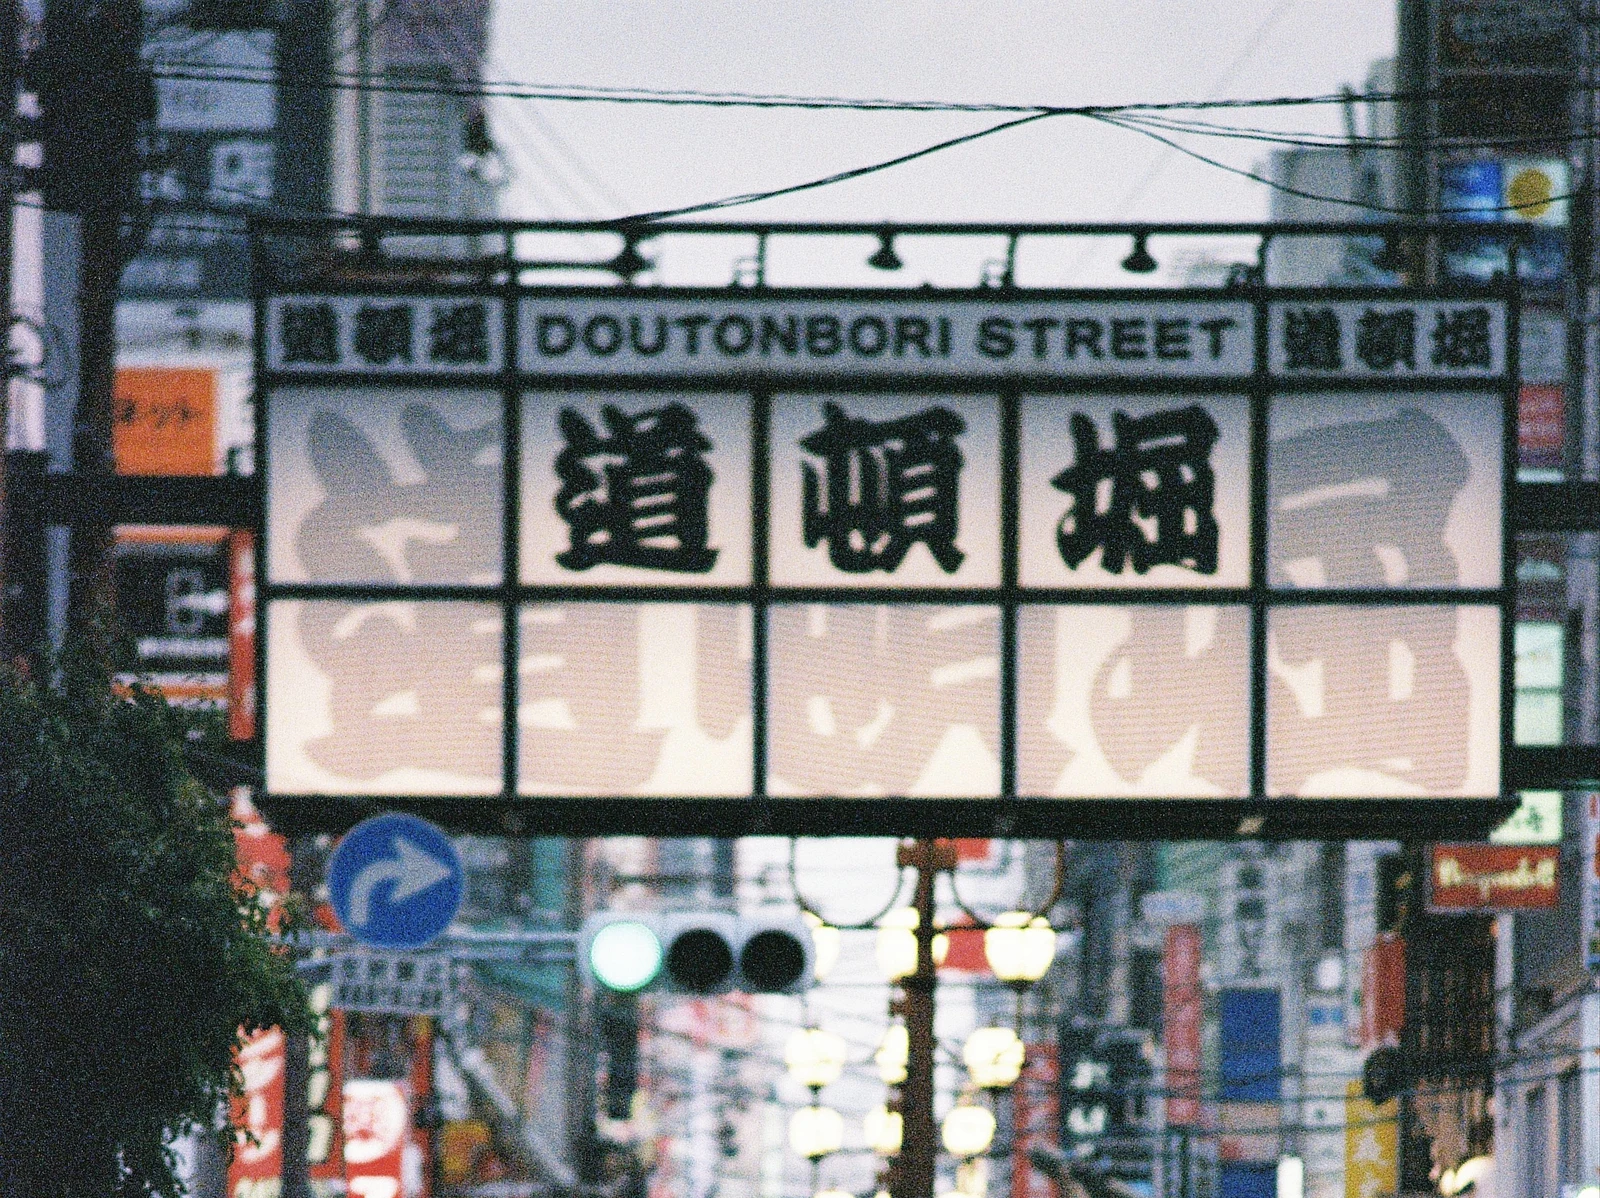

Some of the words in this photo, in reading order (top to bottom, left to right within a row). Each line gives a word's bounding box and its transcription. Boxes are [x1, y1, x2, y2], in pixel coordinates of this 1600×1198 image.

[537, 313, 953, 361] DOUTONBORI
[976, 317, 1238, 361] STREET
[1283, 305, 1493, 372] 道頓堀
[554, 401, 1221, 576] 道頓堀
